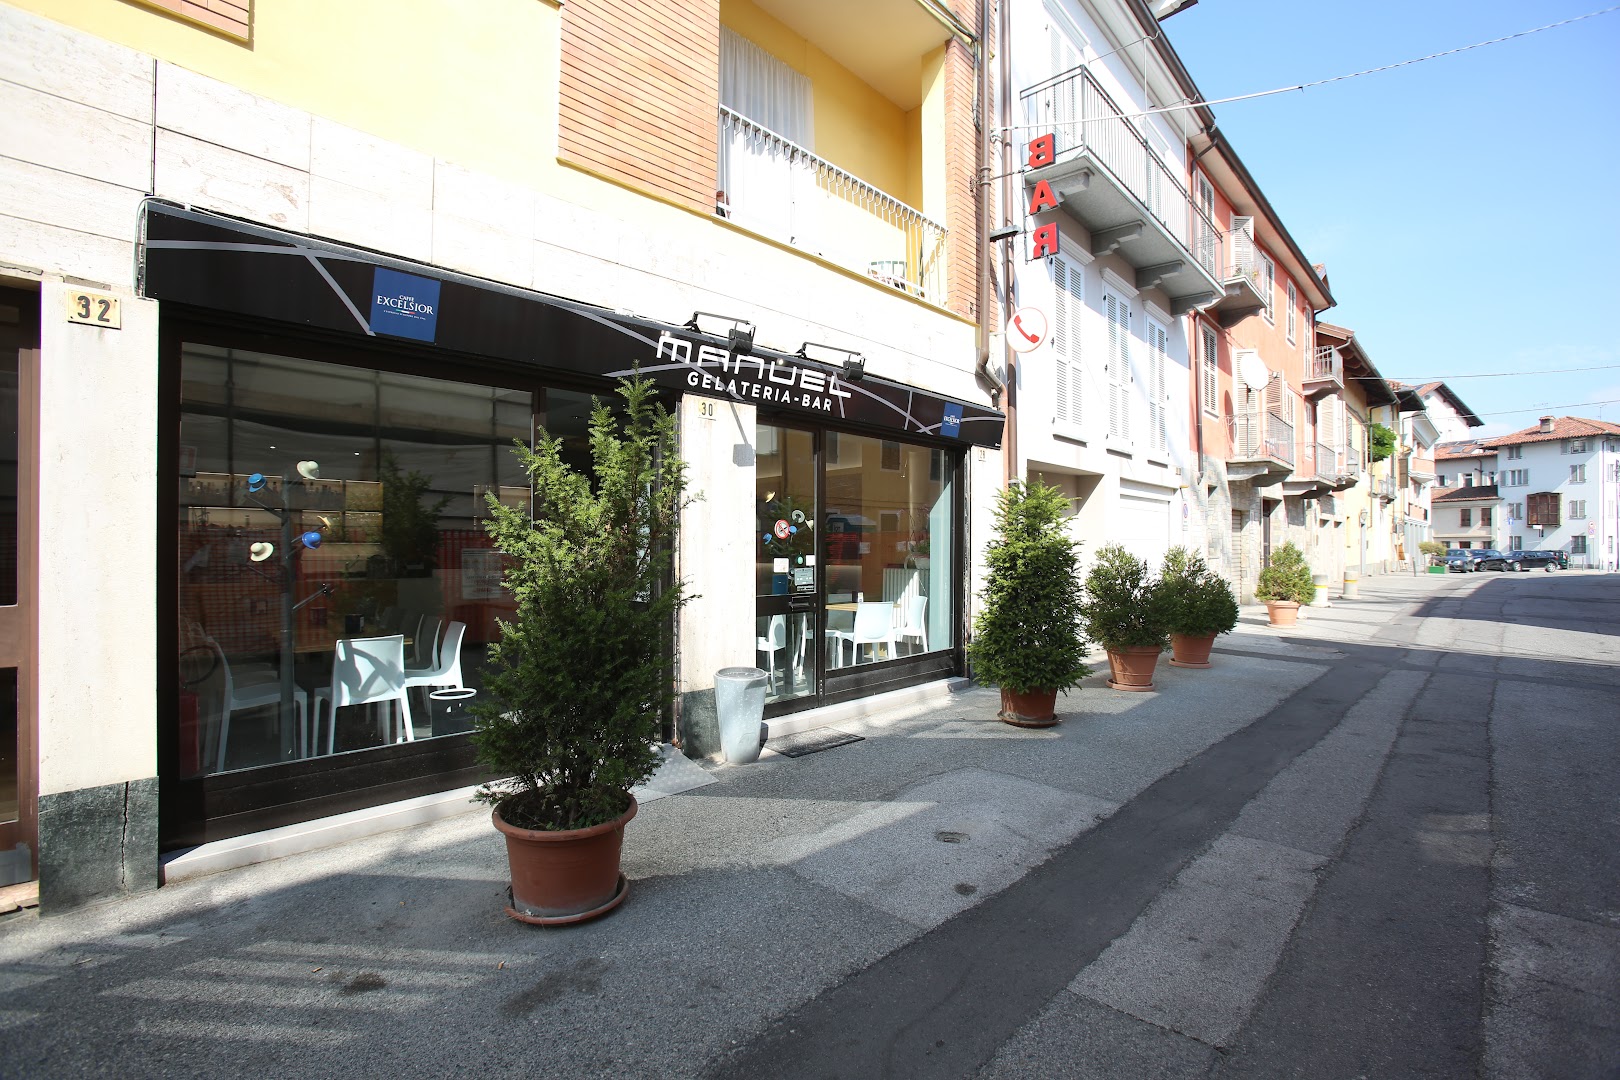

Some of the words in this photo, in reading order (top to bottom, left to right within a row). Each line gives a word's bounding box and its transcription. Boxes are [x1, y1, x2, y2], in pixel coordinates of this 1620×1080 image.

[78, 295, 110, 322] 32
[376, 295, 434, 315] EXCELSIOR
[656, 335, 851, 398] MANUEL
[687, 371, 832, 411] GELATERIA-BAR
[701, 401, 713, 416] 30
